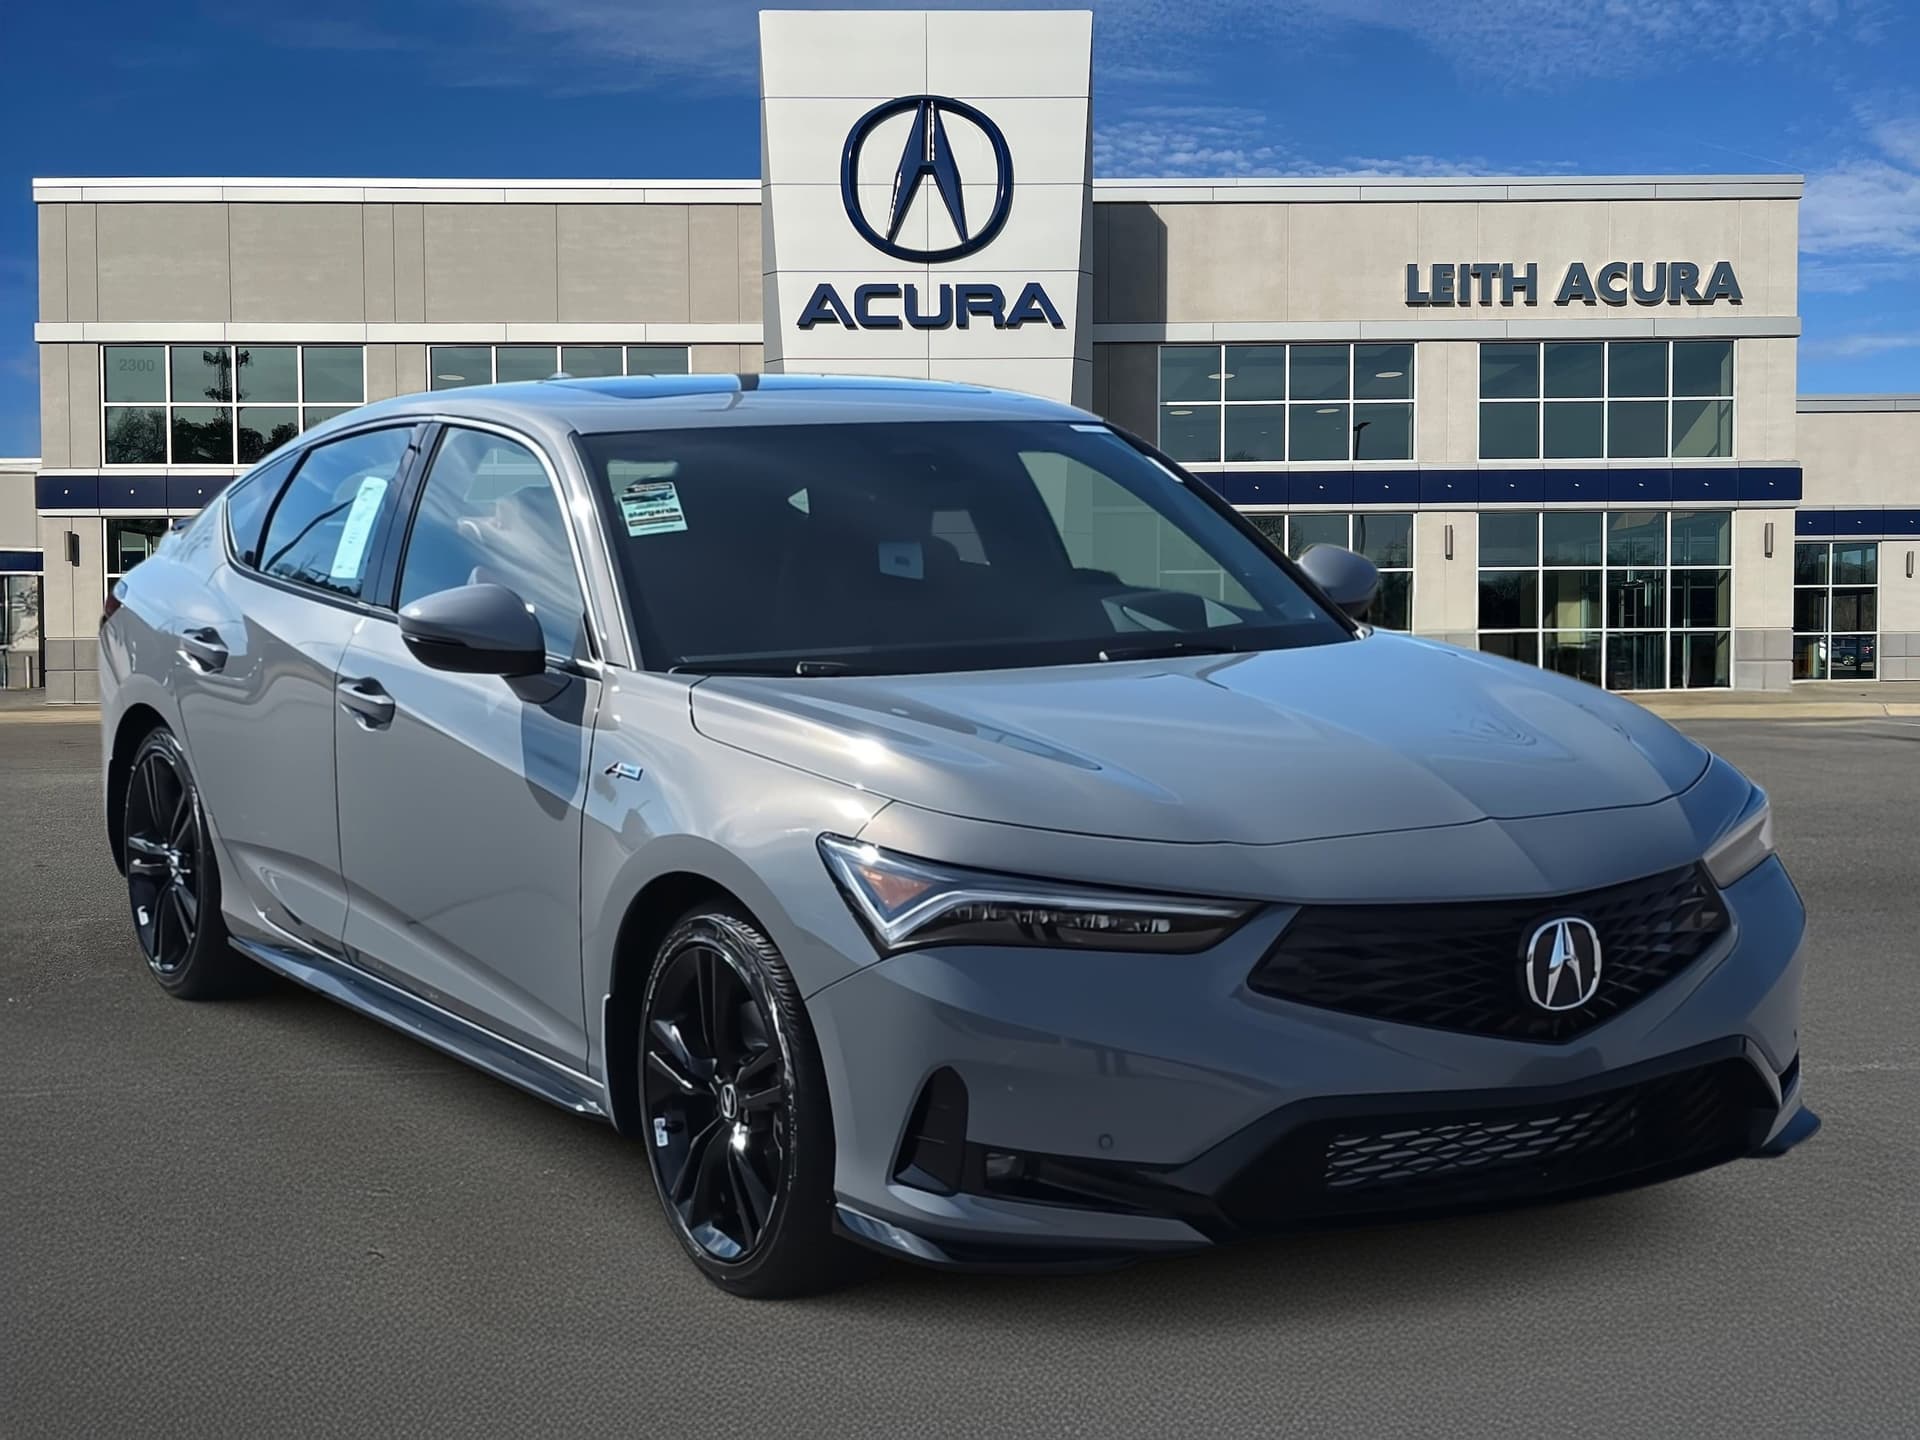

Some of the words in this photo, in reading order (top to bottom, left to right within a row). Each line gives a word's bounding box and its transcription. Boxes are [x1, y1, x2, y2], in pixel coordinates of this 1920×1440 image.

[797, 282, 1066, 330] ACURA
[1405, 262, 1538, 307] LEITH
[1553, 261, 1744, 307] ACURA
[119, 358, 155, 372] 2300
